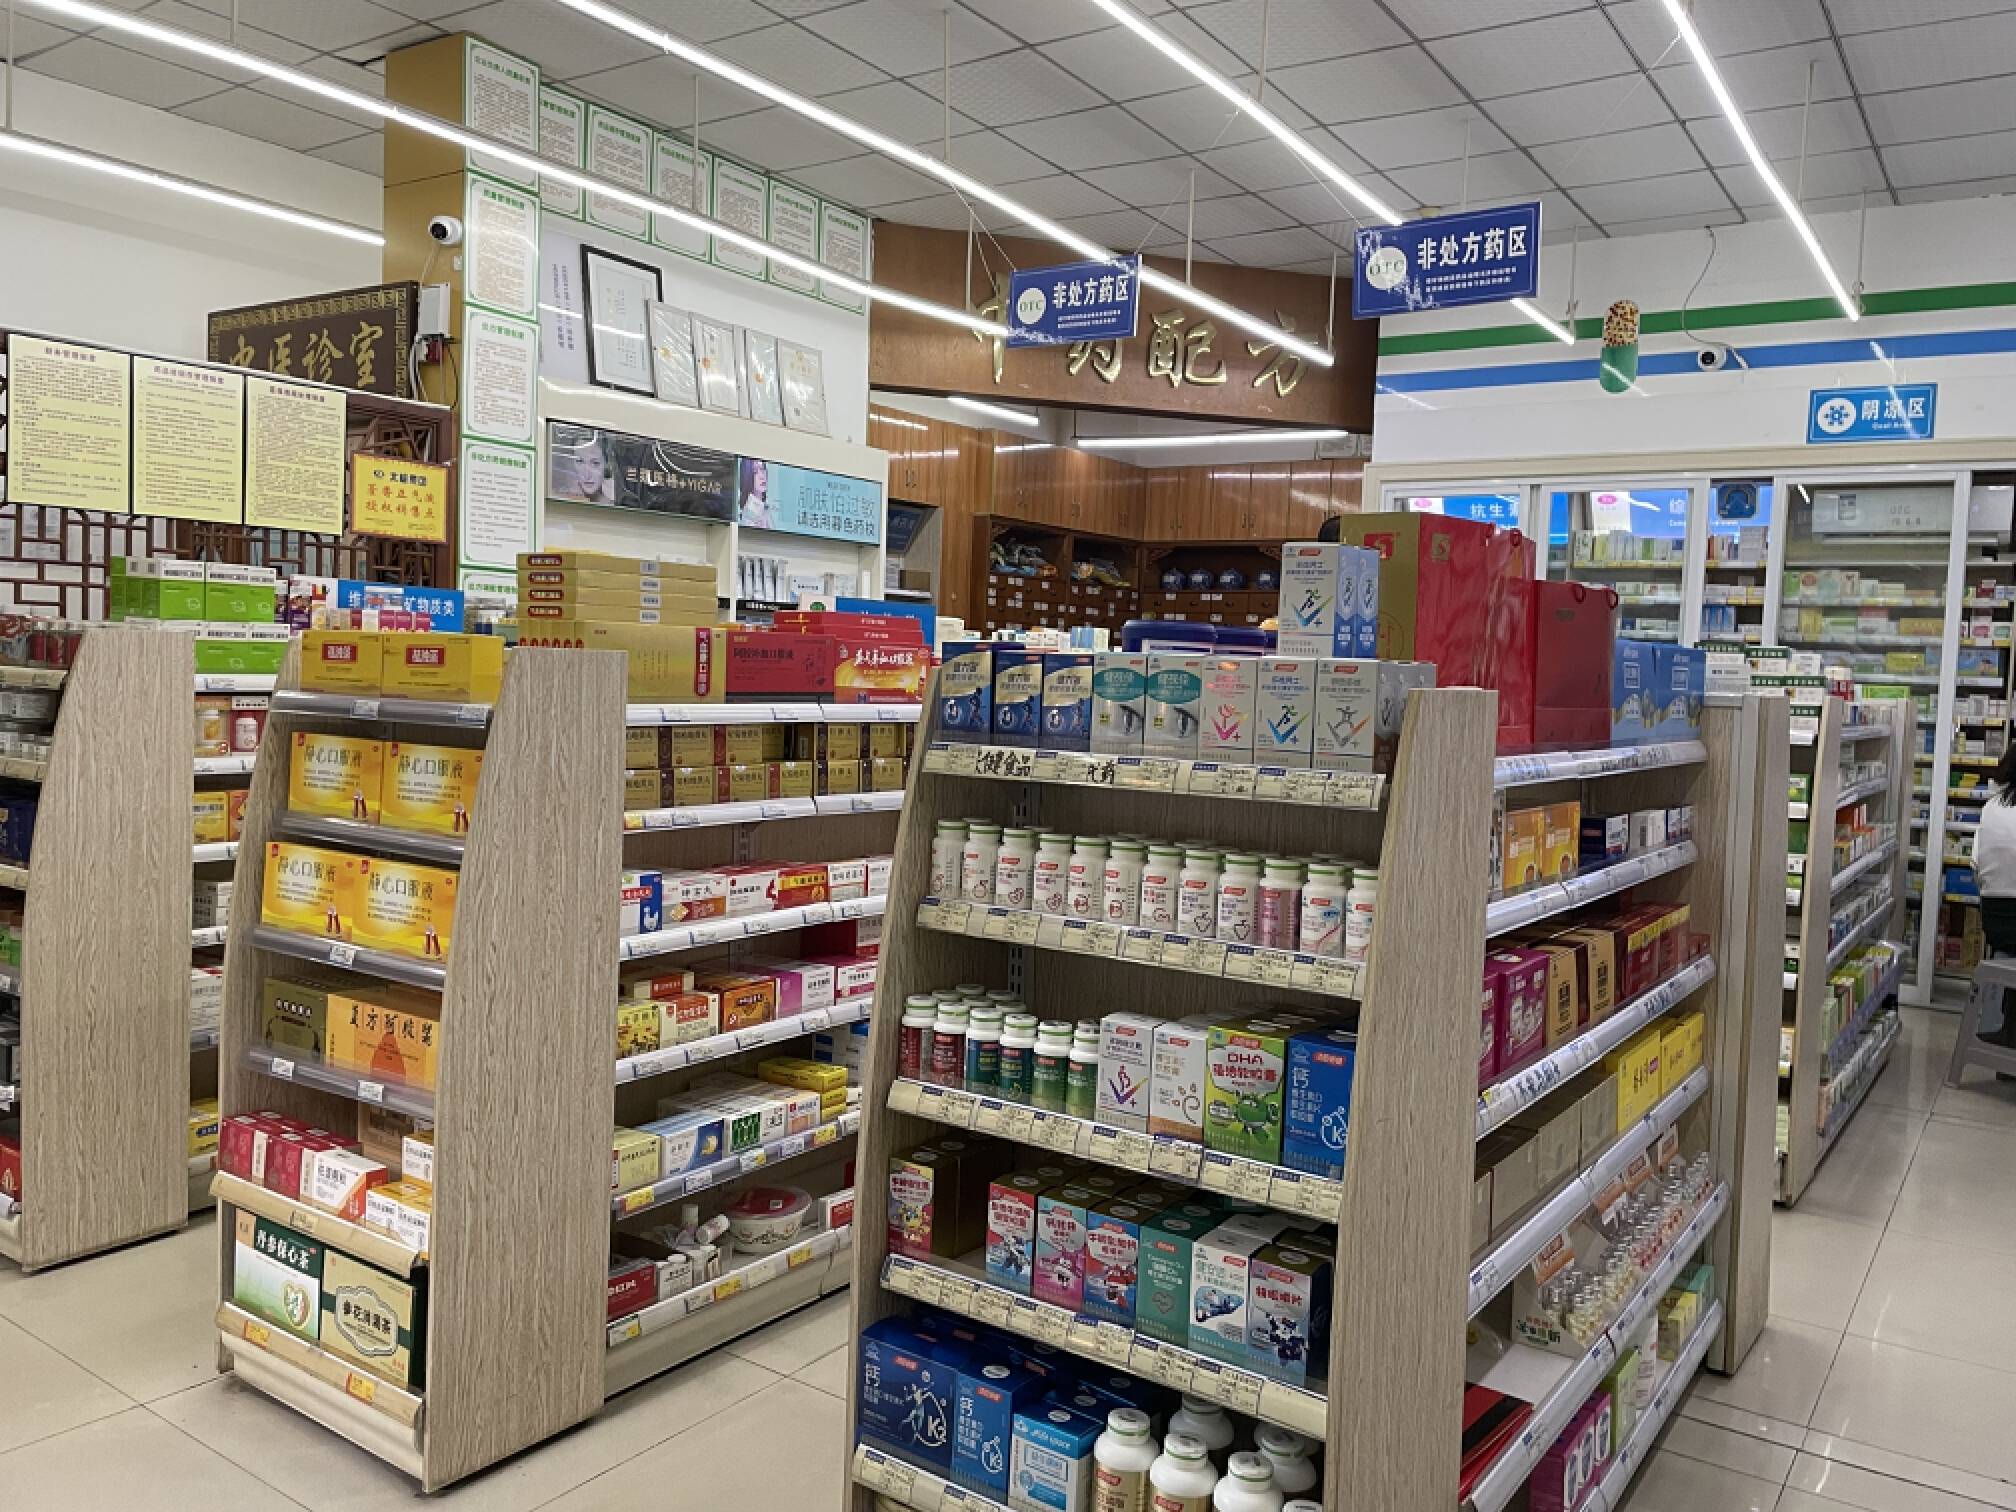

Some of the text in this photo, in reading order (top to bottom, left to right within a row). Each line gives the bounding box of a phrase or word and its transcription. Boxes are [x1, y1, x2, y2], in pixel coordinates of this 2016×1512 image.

[1417, 226, 1527, 270] 非处方药区
[1369, 261, 1404, 275] OTC
[1052, 275, 1129, 309] 非处方药区
[1020, 300, 1044, 312] OTC
[229, 320, 384, 388] 中医诊室
[1861, 397, 1926, 420] 阴凉区
[304, 744, 362, 768] 静心口服液
[398, 754, 464, 779] 静心口服液
[278, 856, 337, 883] 静心口服液
[368, 870, 434, 900] 静心口服液
[1227, 1052, 1264, 1065] DHA
[1291, 1066, 1311, 1089] 钙
[256, 1228, 310, 1271] 丹参保心茶
